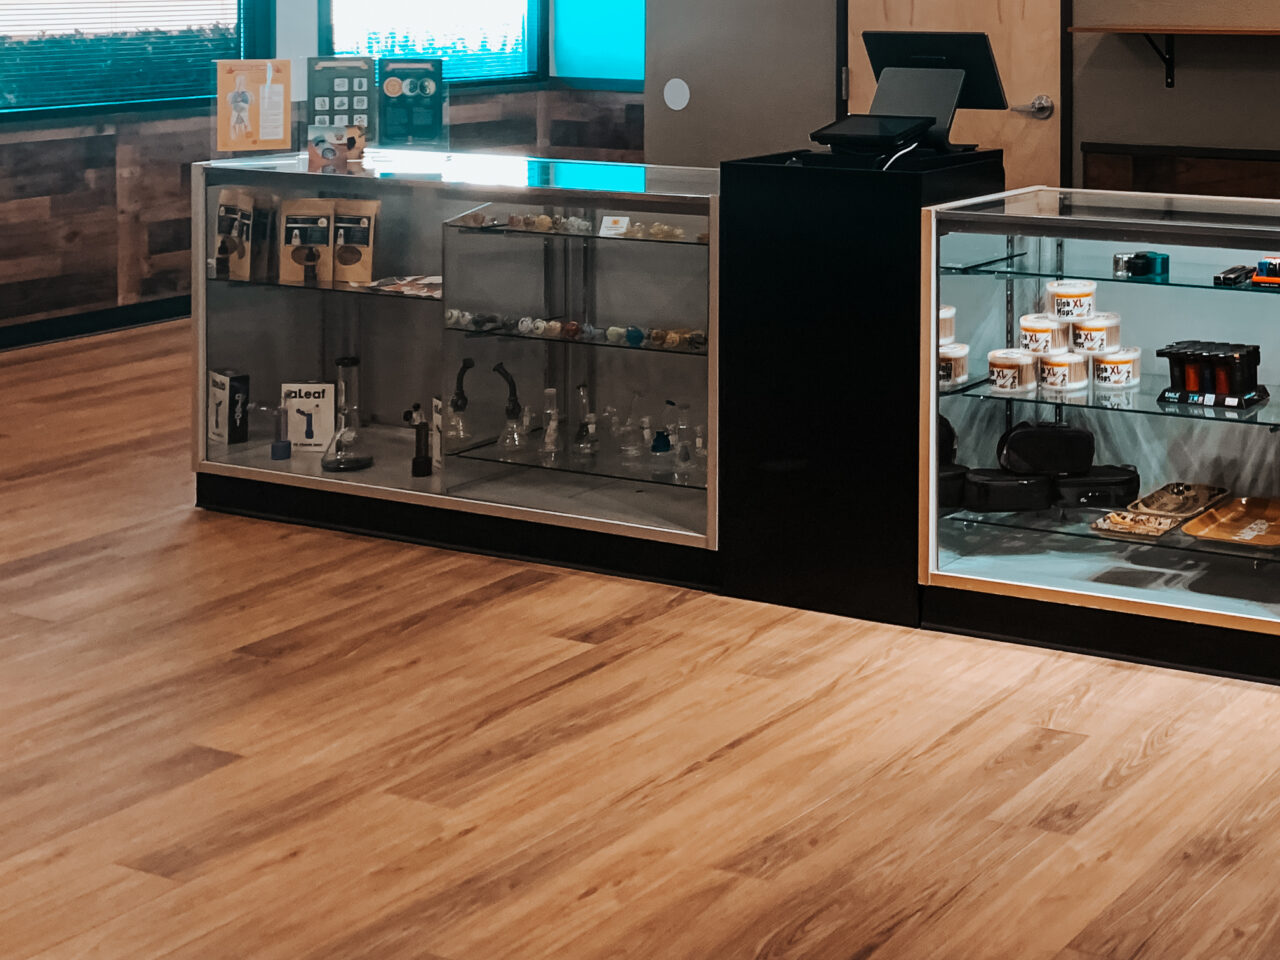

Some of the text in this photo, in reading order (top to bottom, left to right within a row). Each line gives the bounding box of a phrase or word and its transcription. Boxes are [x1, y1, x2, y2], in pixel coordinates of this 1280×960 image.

[1072, 299, 1083, 309] XL
[1028, 333, 1039, 343] XL
[1083, 332, 1095, 342] XL
[1109, 365, 1121, 375] XL
